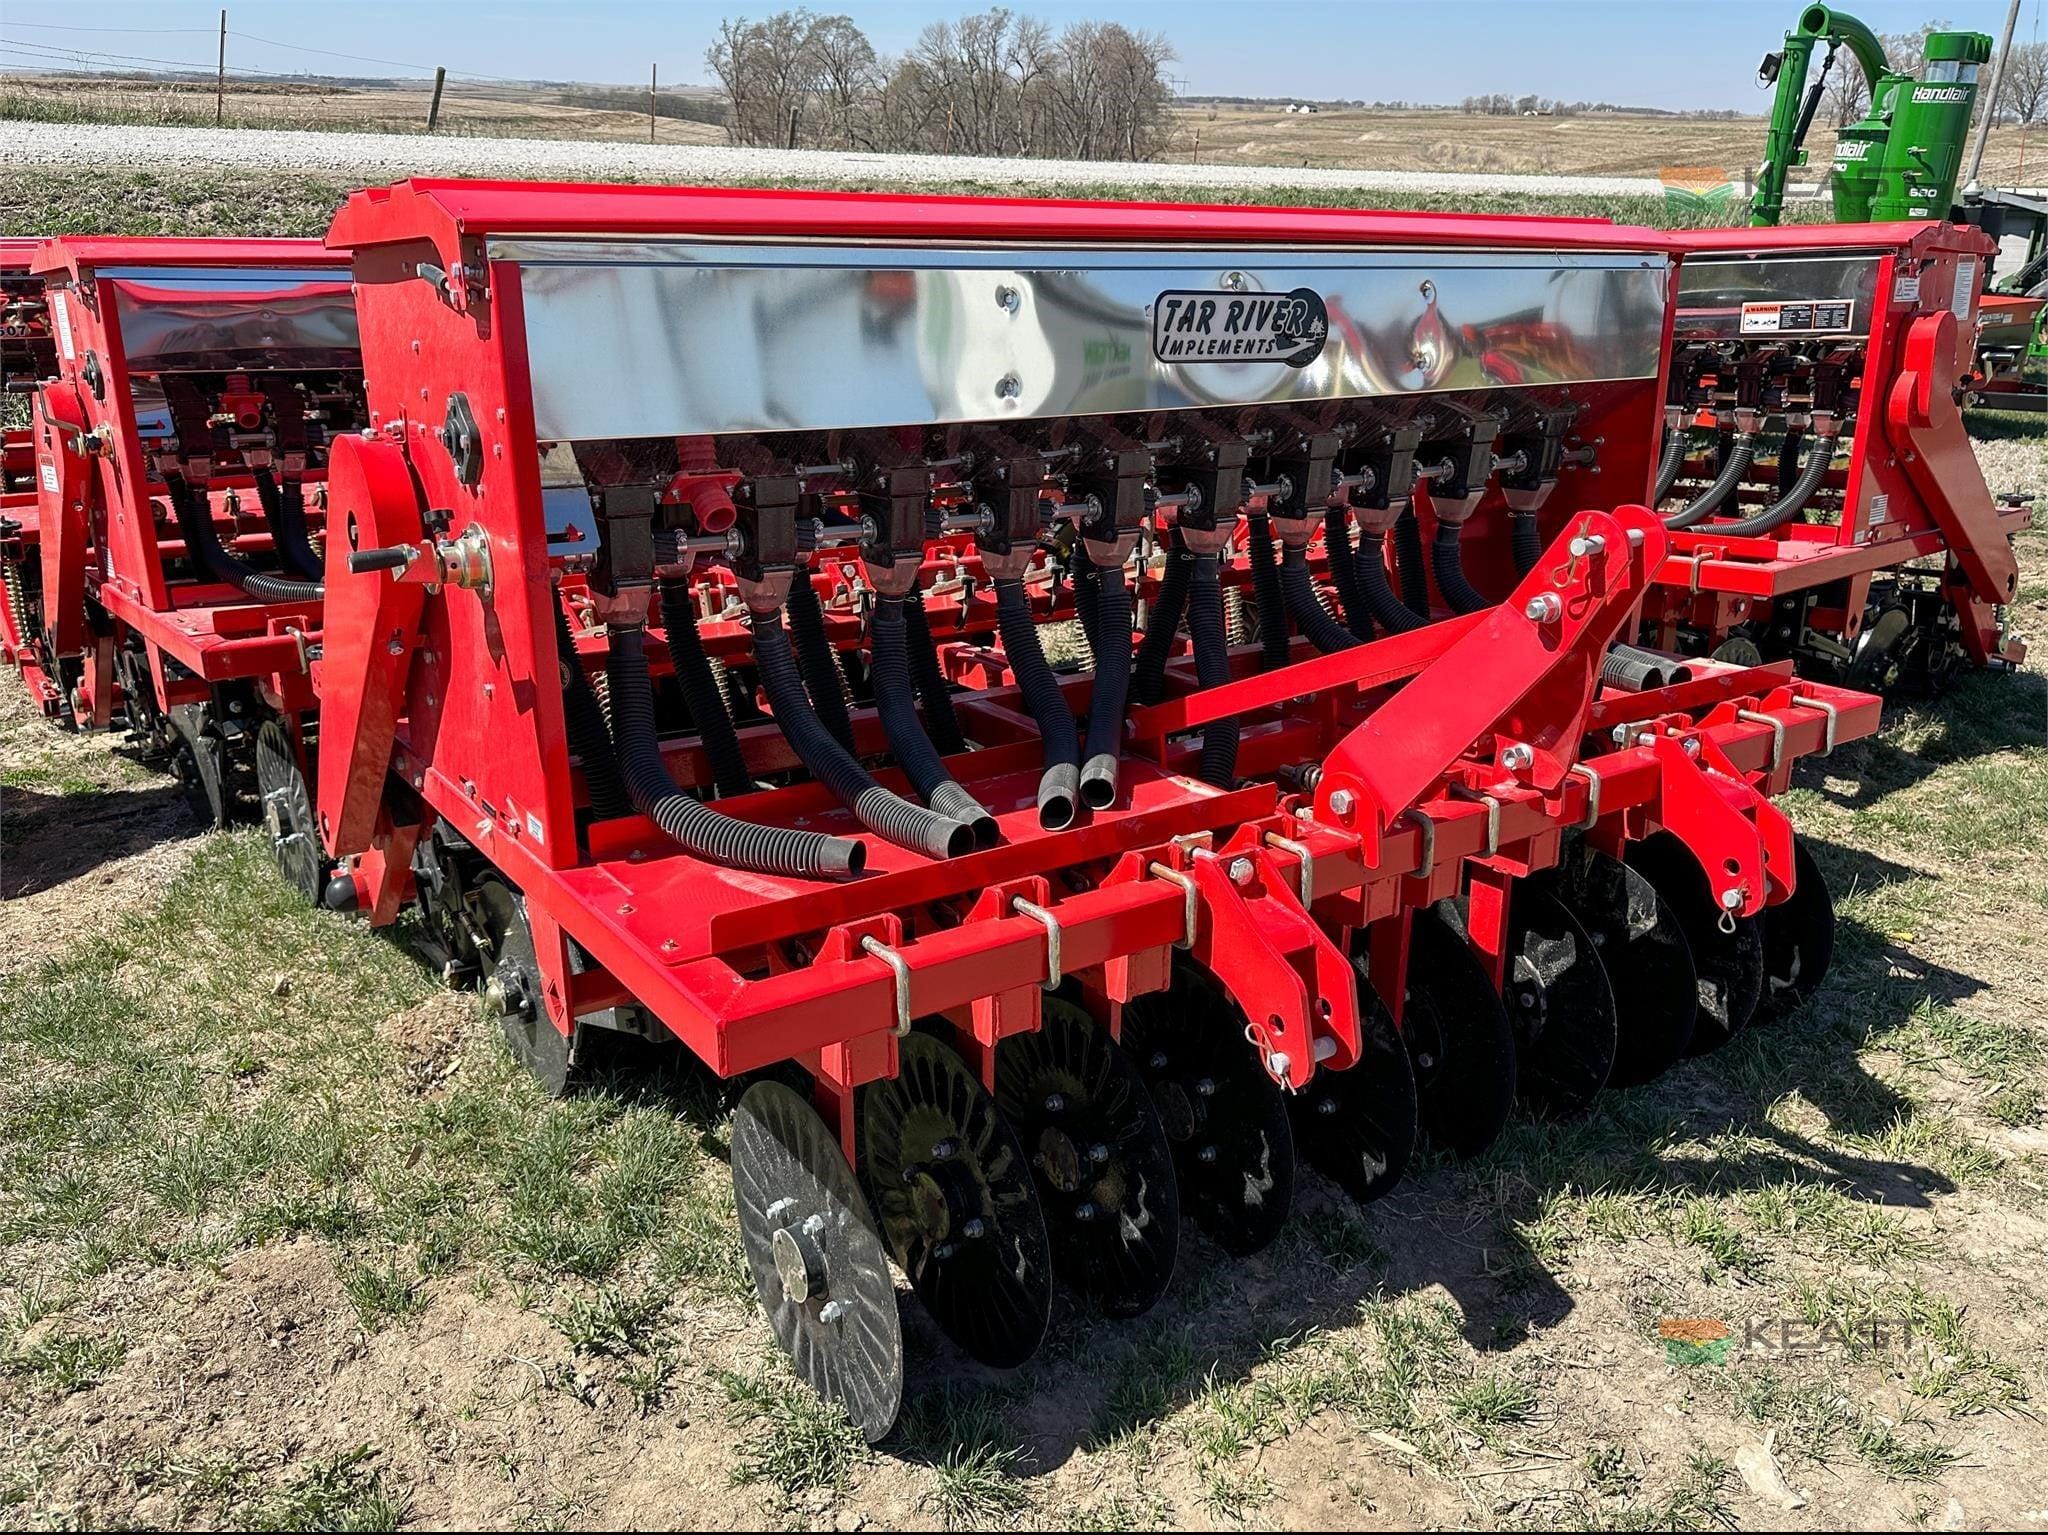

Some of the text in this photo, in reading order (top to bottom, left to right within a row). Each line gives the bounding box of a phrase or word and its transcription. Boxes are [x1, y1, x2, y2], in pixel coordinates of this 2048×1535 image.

[1911, 86, 1970, 101] Handlair
[1834, 140, 1873, 157] ndlair
[1163, 298, 1308, 336] TAR RIVER
[1160, 335, 1277, 356] IMPLEMENTS
